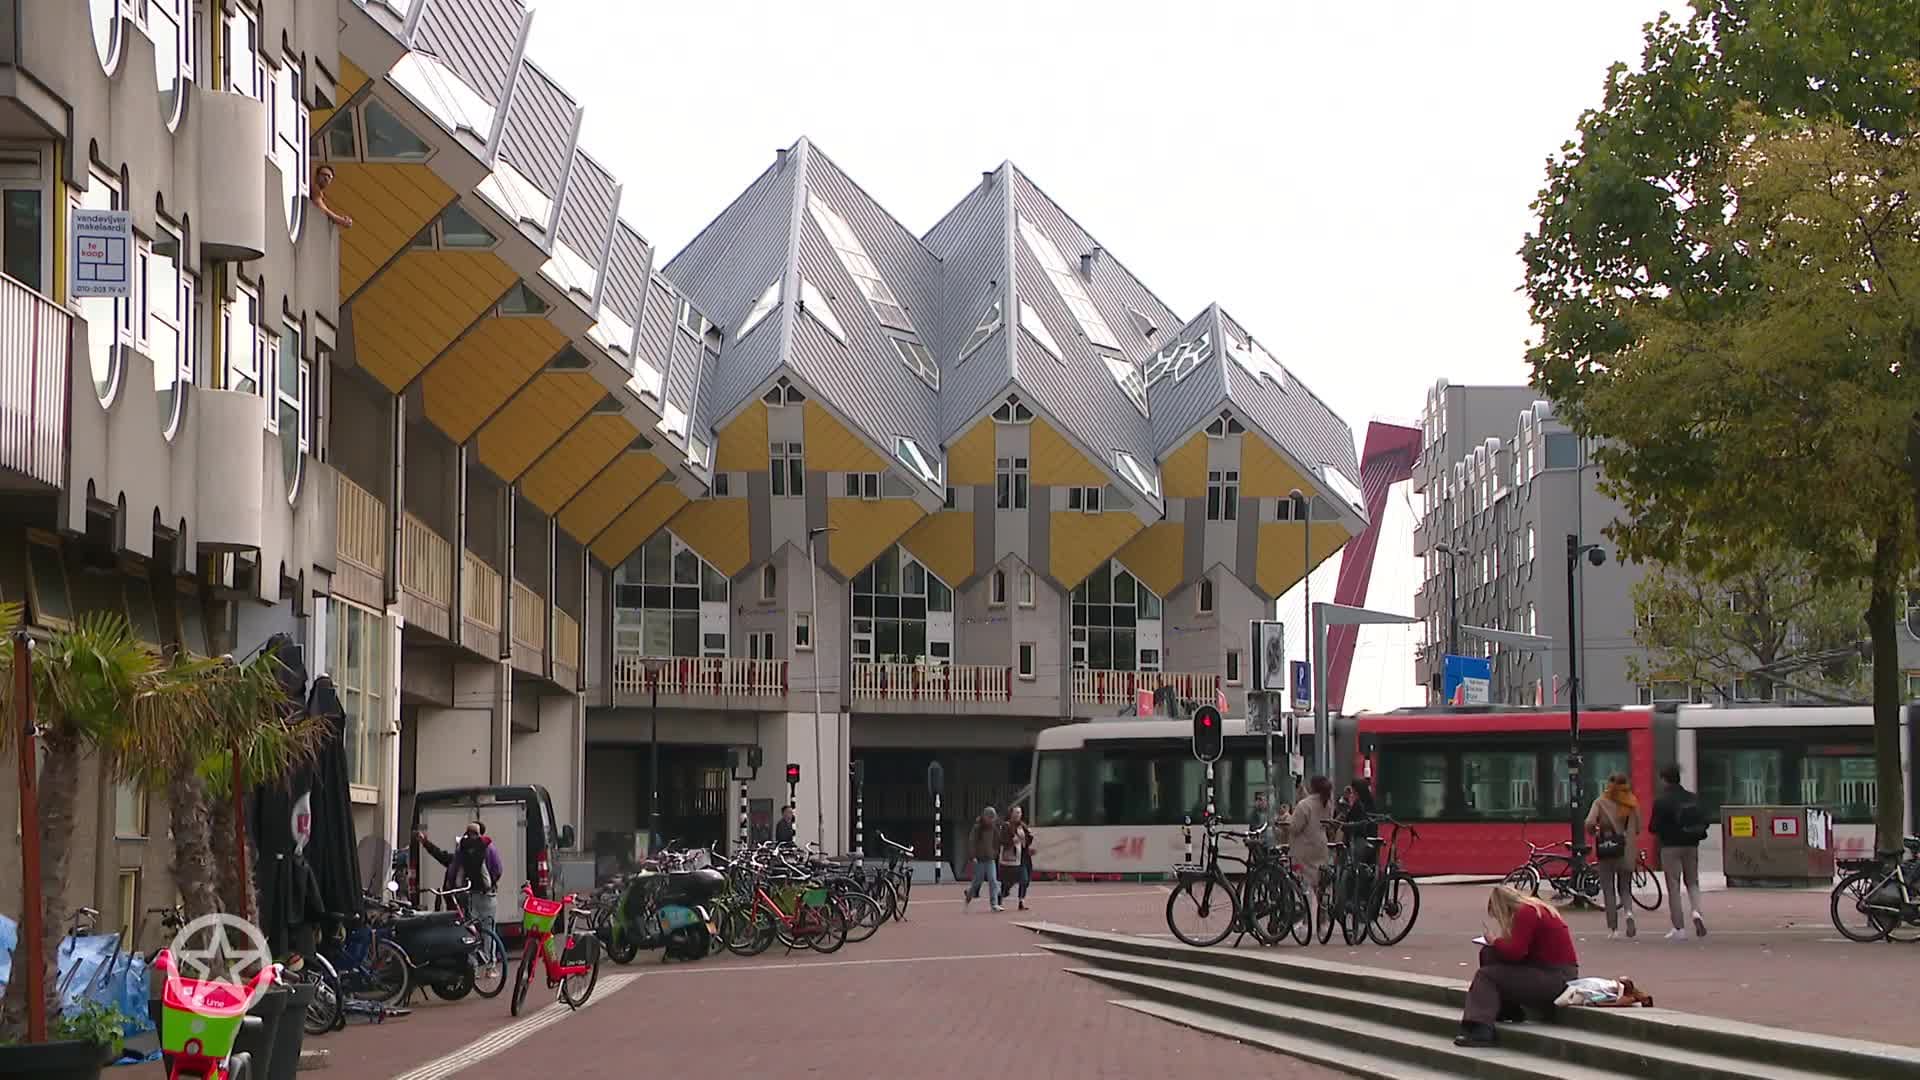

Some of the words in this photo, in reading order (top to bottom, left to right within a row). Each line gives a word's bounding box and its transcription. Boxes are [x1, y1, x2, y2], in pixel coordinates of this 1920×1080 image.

[77, 223, 126, 234] makelaardij
[81, 249, 104, 258] koop
[1782, 822, 1788, 831] B
